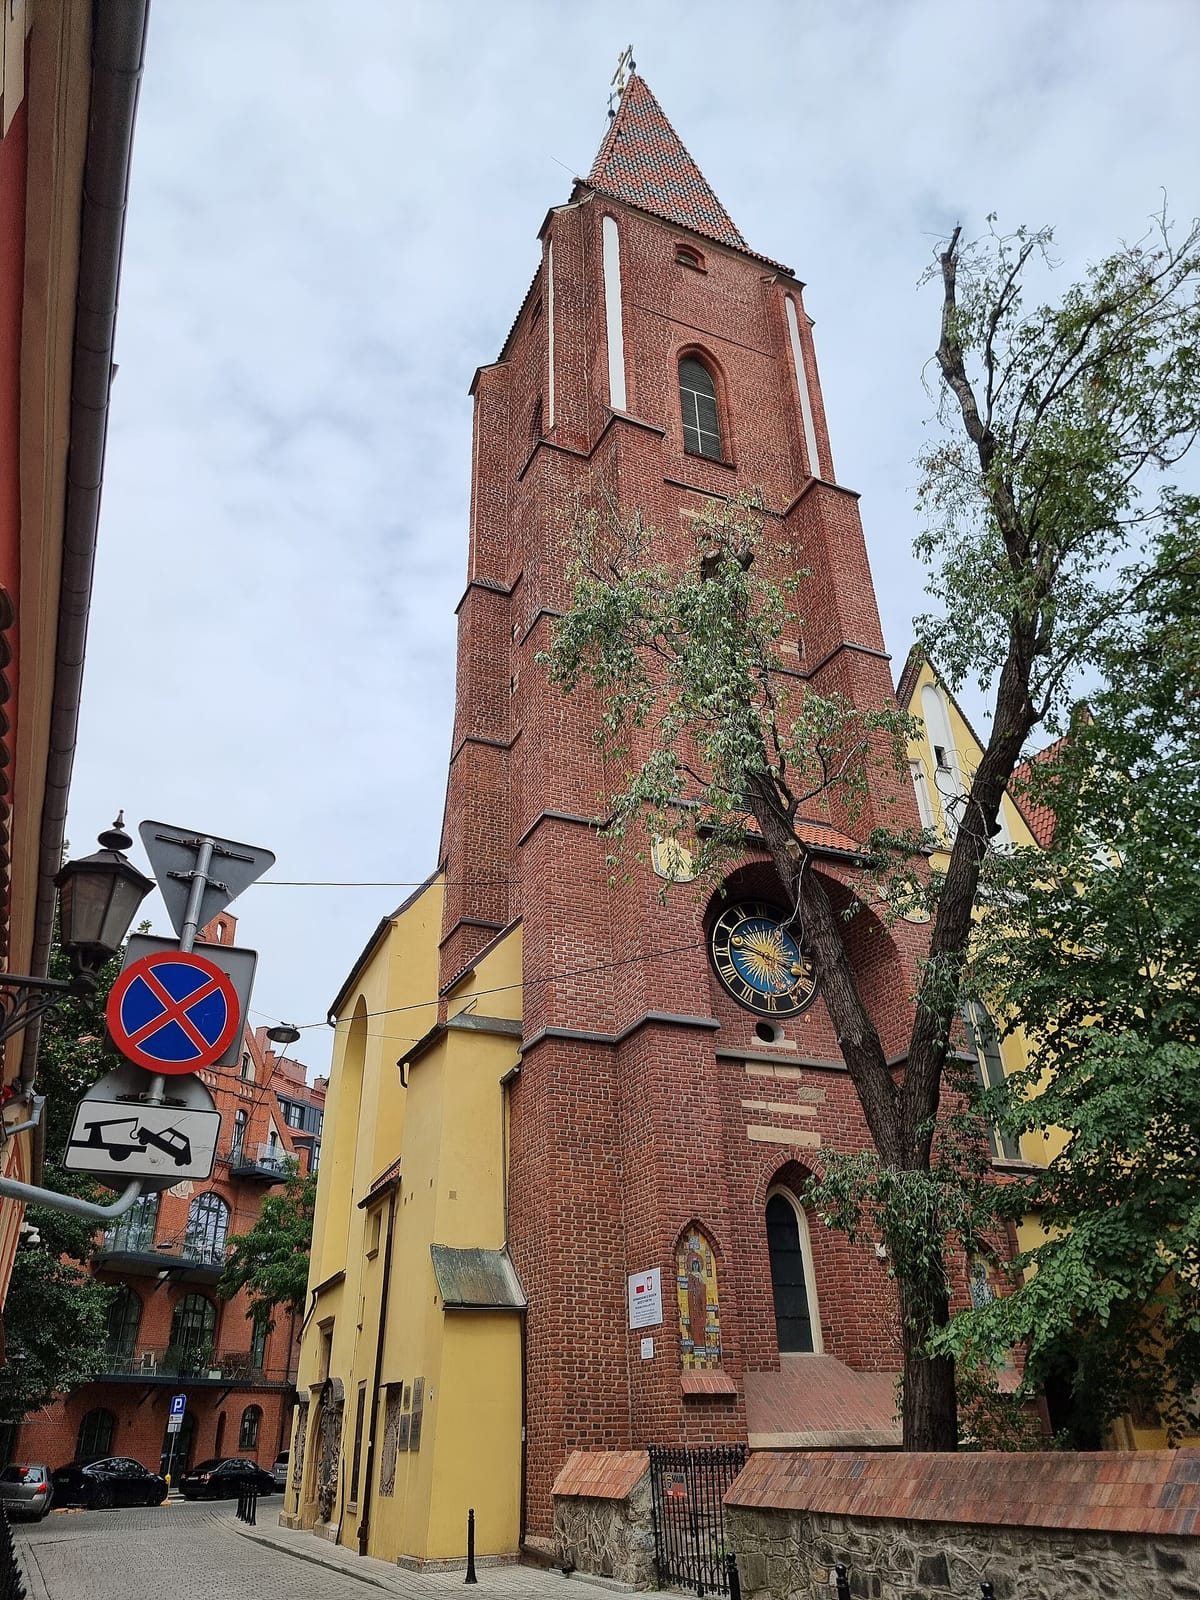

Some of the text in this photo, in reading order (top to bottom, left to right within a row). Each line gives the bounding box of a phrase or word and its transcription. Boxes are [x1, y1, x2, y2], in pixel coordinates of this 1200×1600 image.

[715, 945, 729, 956] IX
[720, 964, 738, 984] VIII
[740, 986, 754, 1004] VII
[173, 1398, 182, 1413] P
